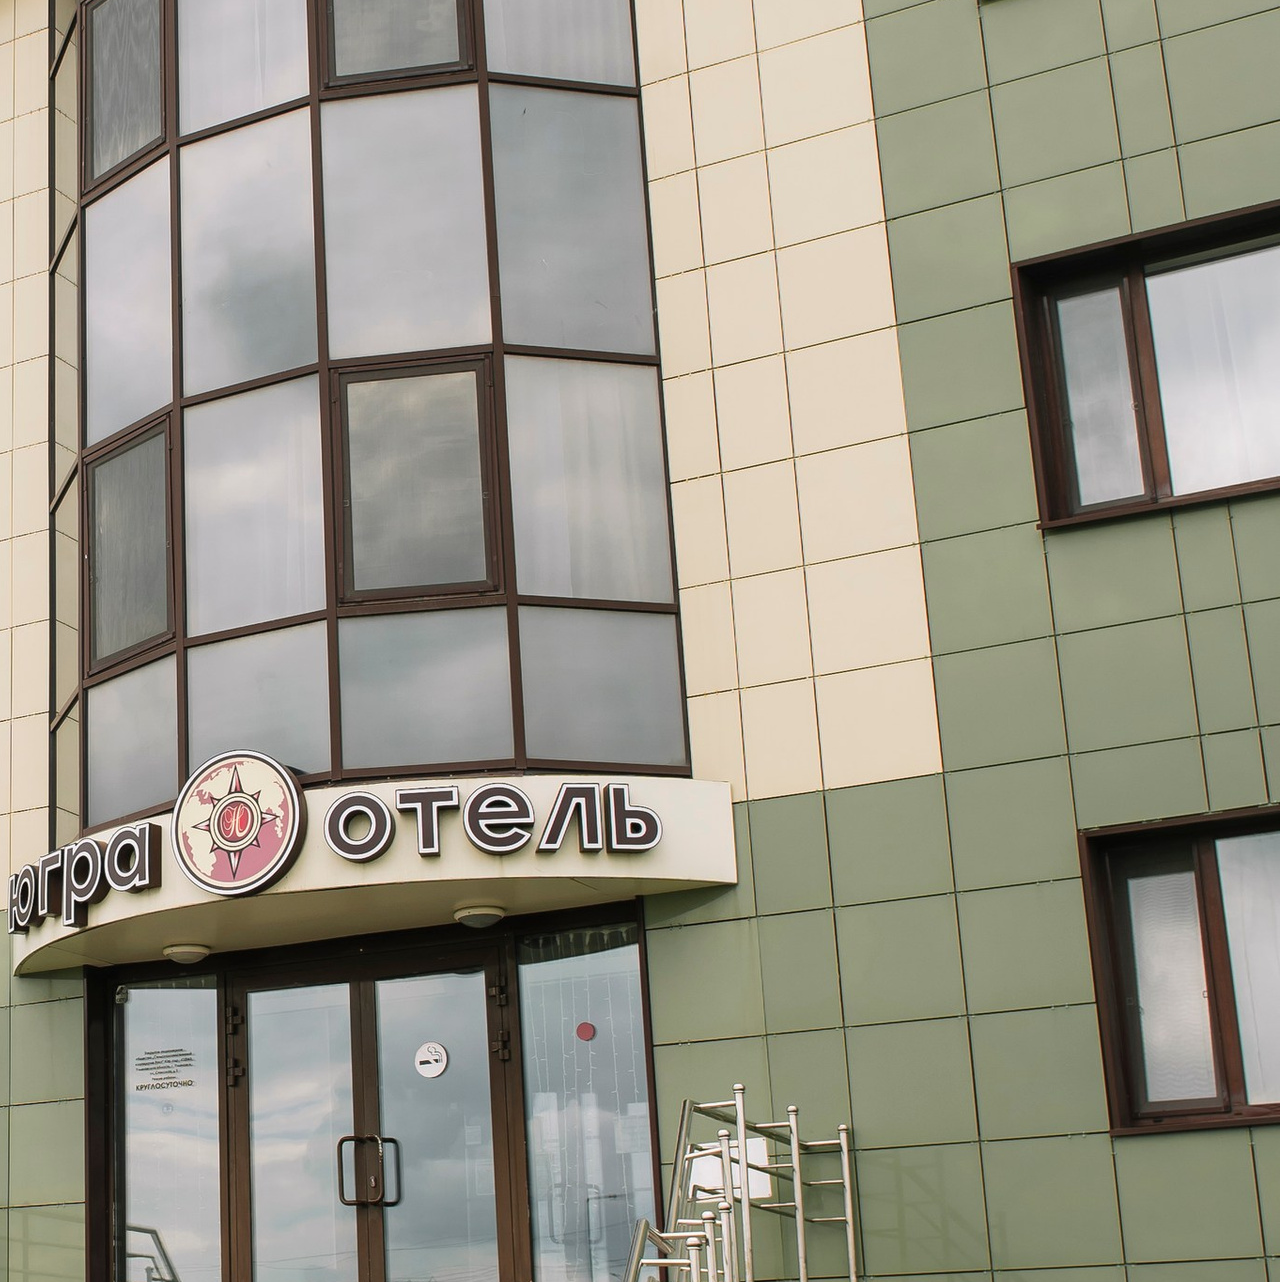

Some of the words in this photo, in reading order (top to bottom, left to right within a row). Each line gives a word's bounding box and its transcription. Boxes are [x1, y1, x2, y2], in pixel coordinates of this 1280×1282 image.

[7, 822, 162, 934] югра
[323, 782, 663, 863] отель
[135, 1079, 193, 1091] КРУГЛОСУТОЧНО
